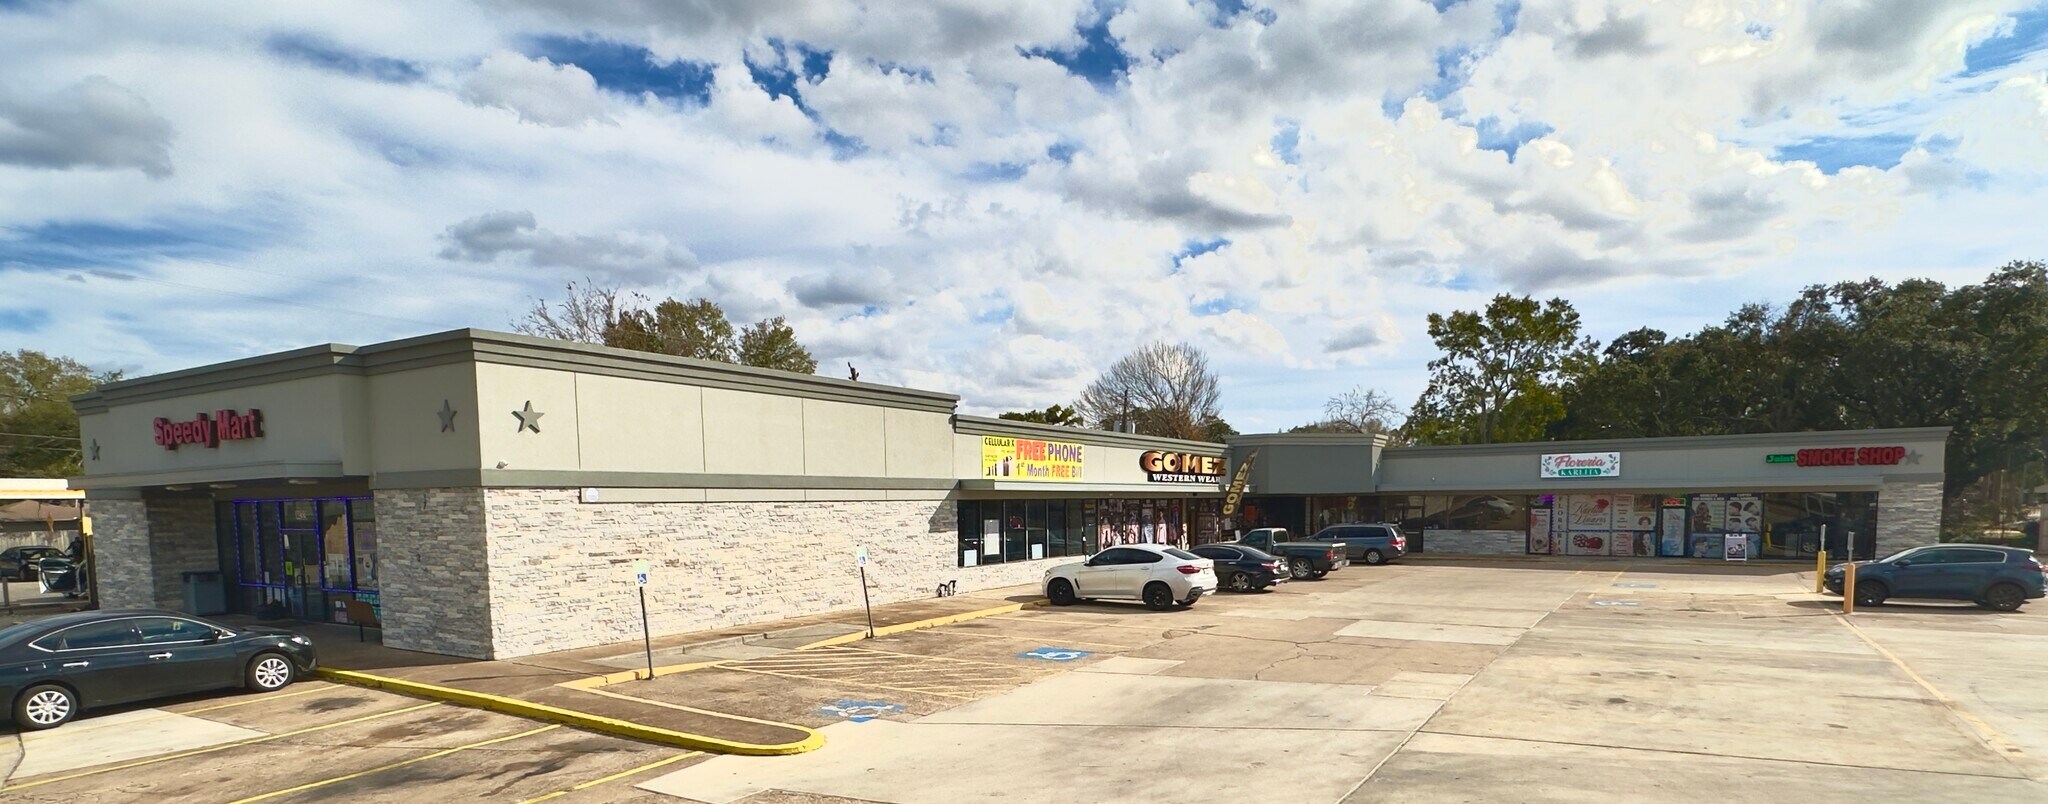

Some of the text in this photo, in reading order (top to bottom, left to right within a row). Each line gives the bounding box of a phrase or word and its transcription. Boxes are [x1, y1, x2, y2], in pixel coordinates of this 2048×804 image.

[153, 408, 262, 450] Speedy Mart
[984, 437, 1010, 447] CELLULAR
[1016, 440, 1082, 463] FREE PHONE
[1139, 450, 1226, 475] GOMEZ
[1797, 448, 1856, 467] SMOKE
[1857, 446, 1906, 465] SHOP
[1027, 463, 1049, 477] Month
[1051, 465, 1070, 478] FREE
[1152, 473, 1196, 482] WESTERN
[1222, 462, 1249, 515] GOMEZ
